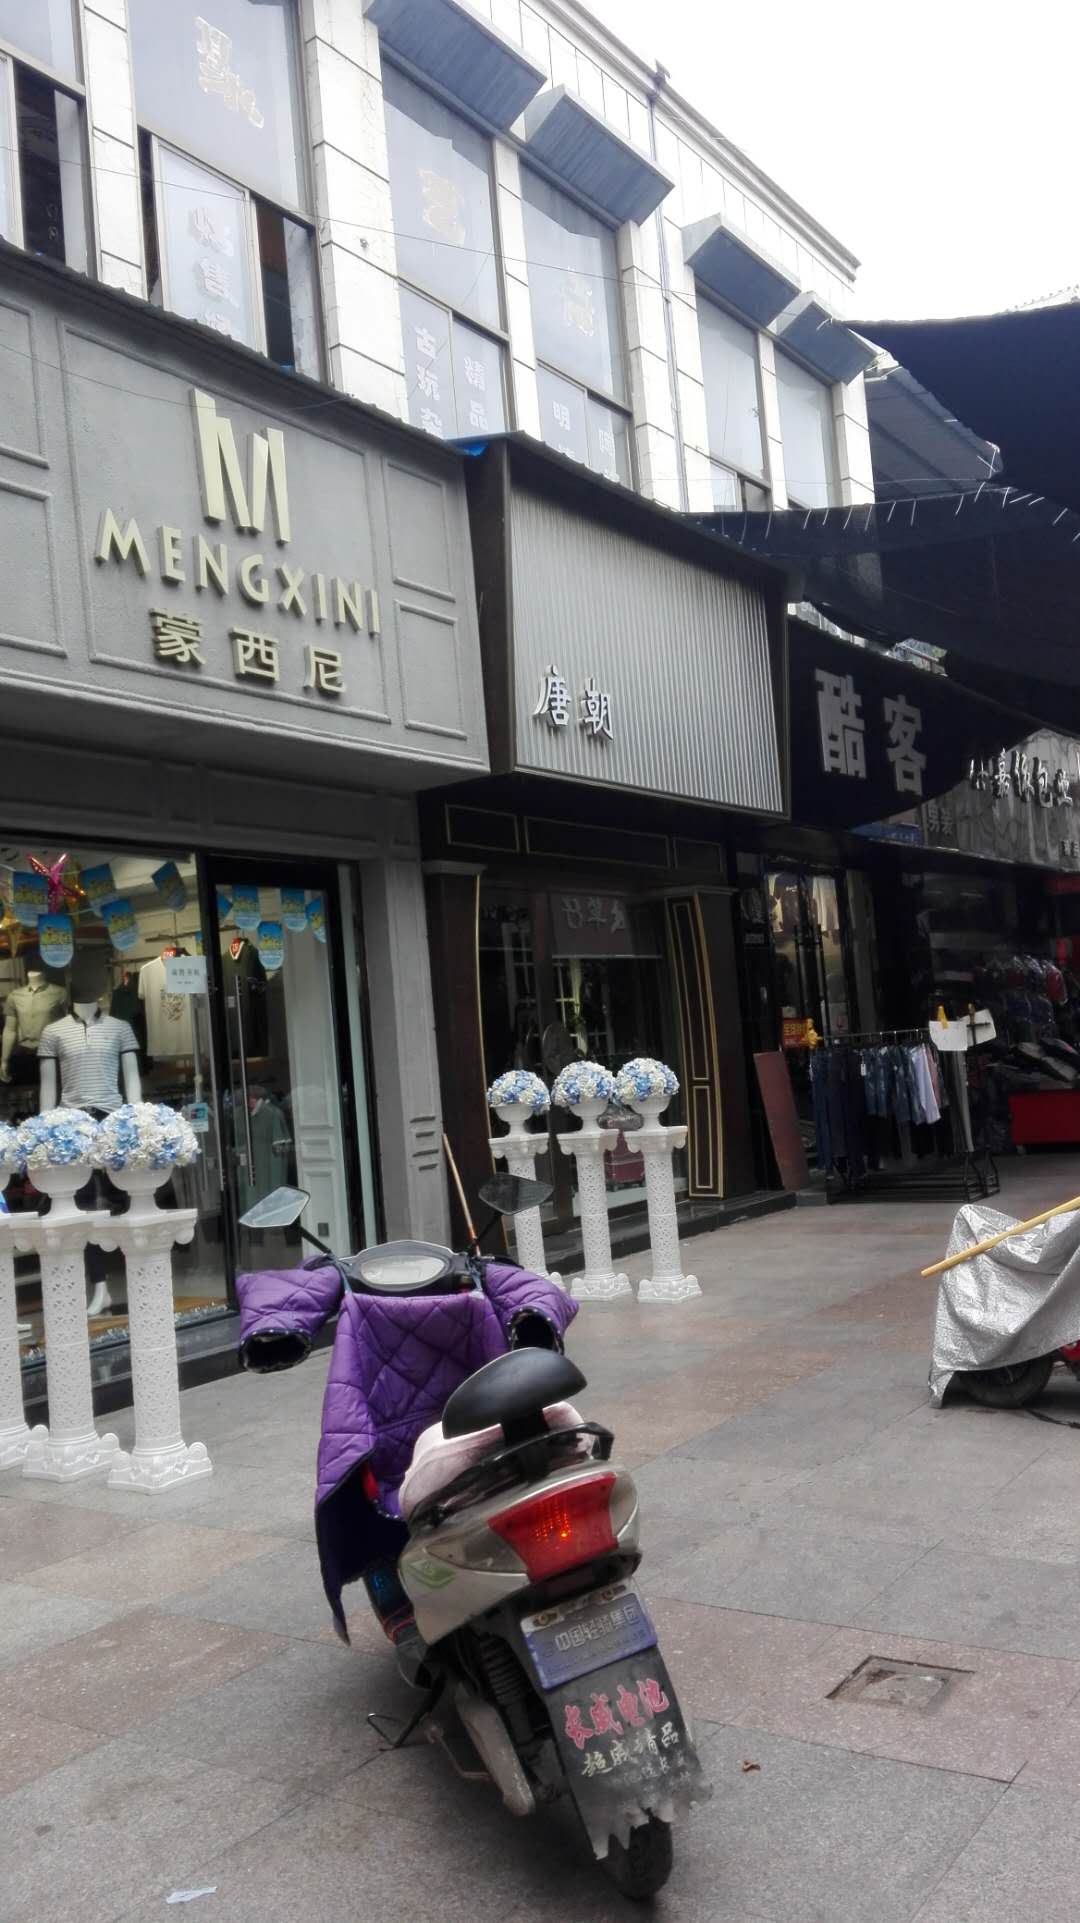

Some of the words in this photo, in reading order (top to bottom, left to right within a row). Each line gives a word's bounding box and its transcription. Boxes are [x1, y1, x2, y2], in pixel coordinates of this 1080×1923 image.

[94, 507, 382, 638] MENGXINI
[150, 607, 347, 696] 蒙西尼
[532, 664, 614, 741] 唐朝
[814, 668, 927, 796] 酷客
